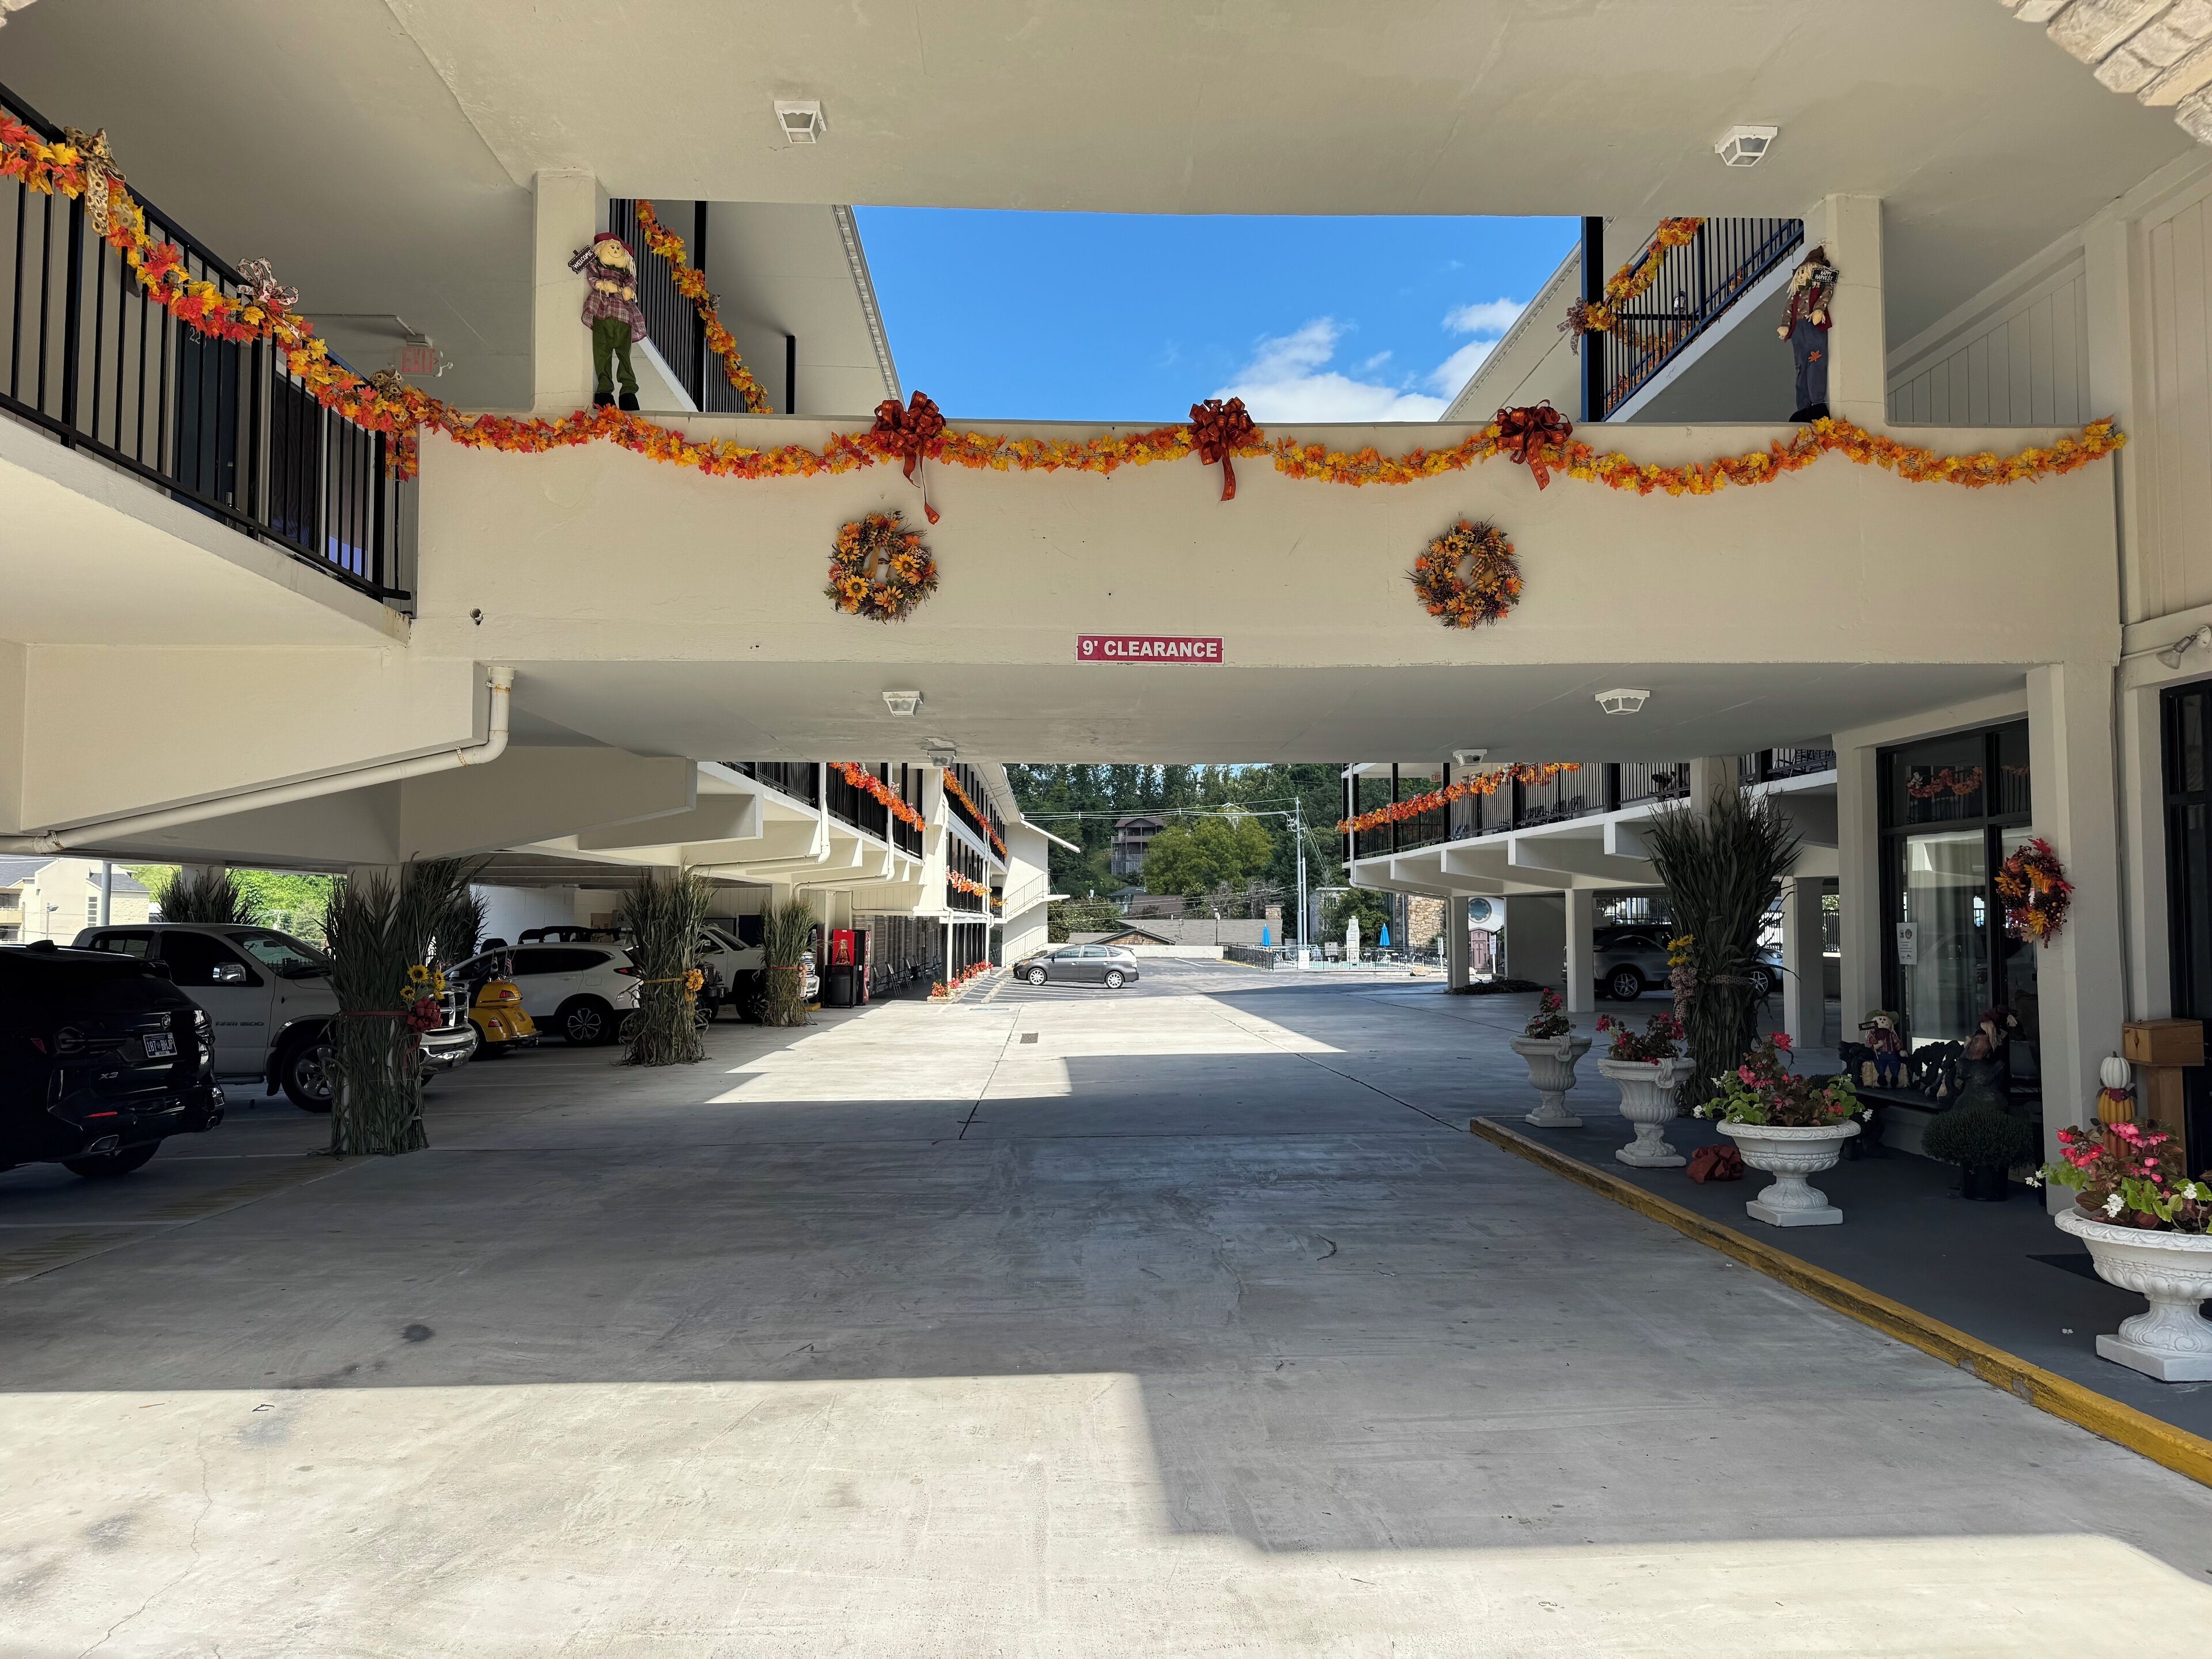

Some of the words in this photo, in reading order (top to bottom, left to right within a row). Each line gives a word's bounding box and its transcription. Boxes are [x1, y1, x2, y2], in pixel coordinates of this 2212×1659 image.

[573, 250, 593, 269] WELCOME
[1815, 274, 1834, 282] HARVEST
[402, 349, 435, 373] EXIT
[1082, 640, 1099, 656] 9'
[1104, 640, 1218, 658] CLEARANCE
[146, 1040, 157, 1052] 187
[98, 1071, 119, 1080] X3
